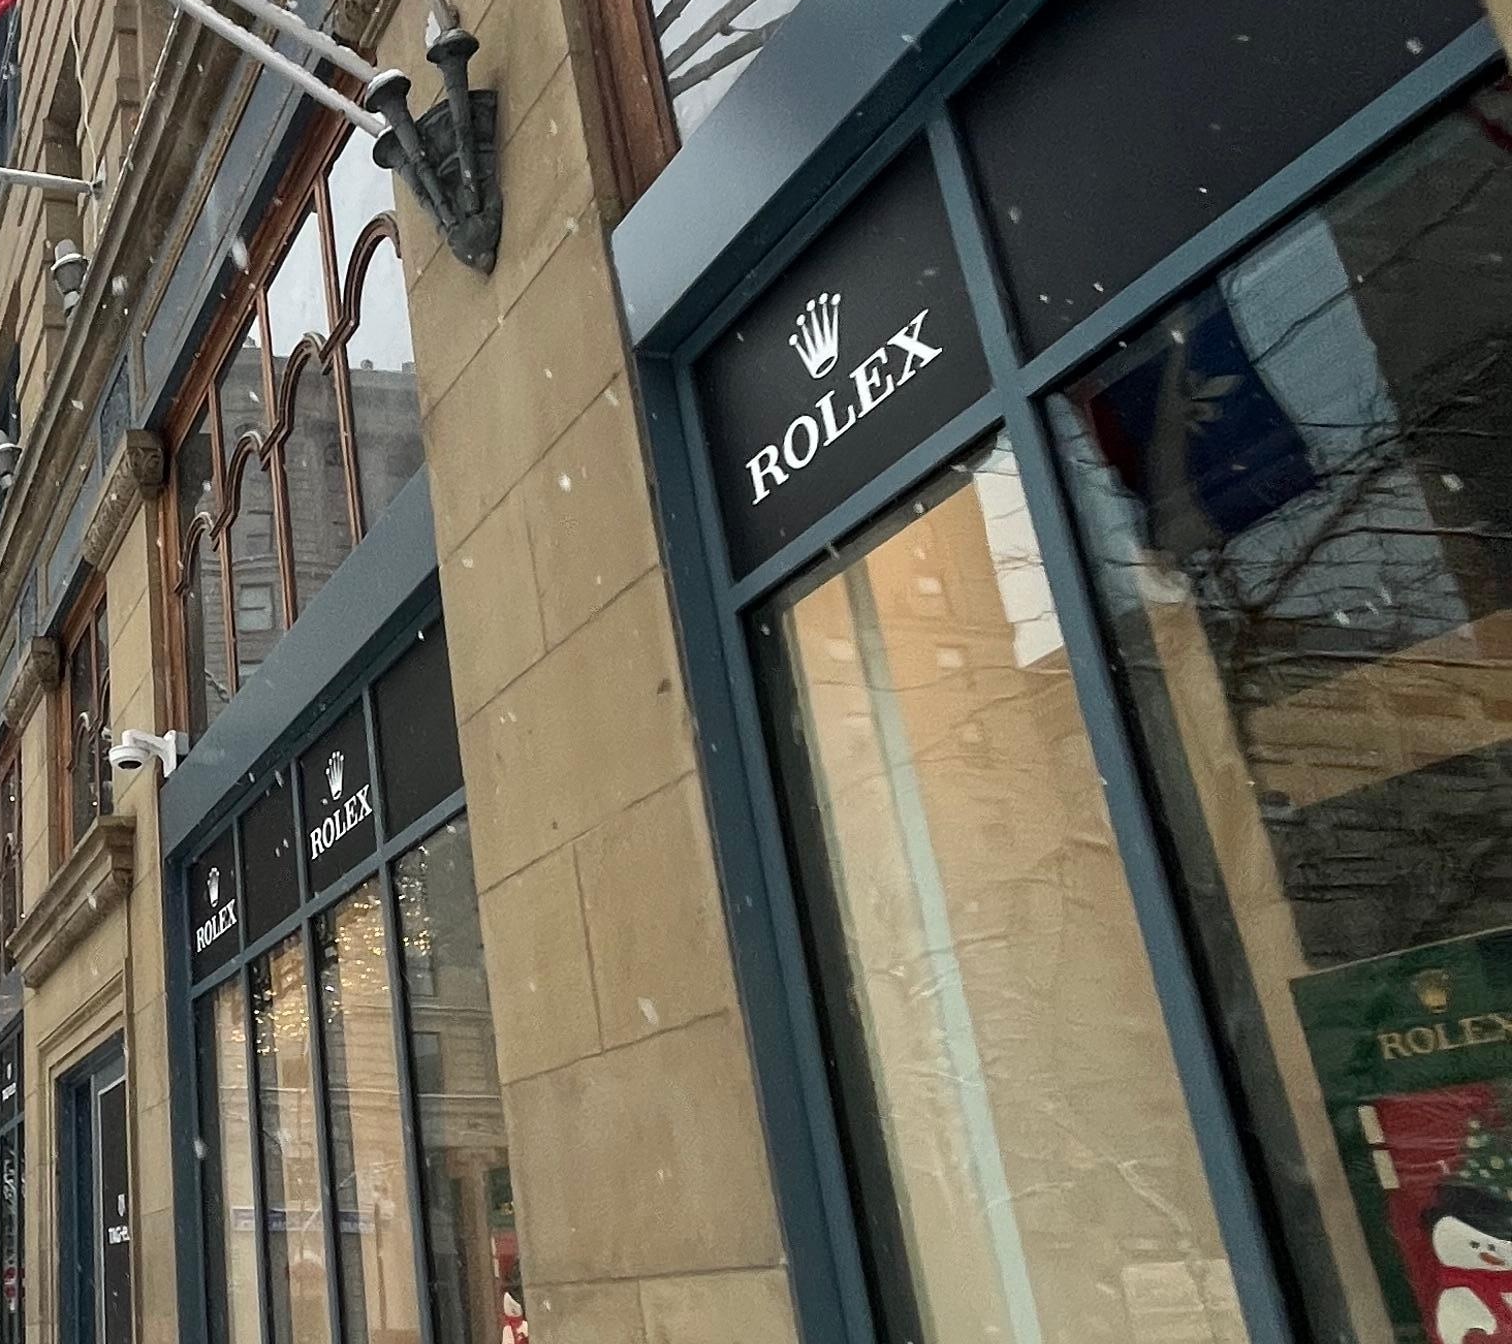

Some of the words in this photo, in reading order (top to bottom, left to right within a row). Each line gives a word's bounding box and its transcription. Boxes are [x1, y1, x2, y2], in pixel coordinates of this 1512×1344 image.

[745, 308, 943, 505] ROLEX
[310, 783, 373, 860] ROLEX
[196, 898, 238, 953] ROLEX
